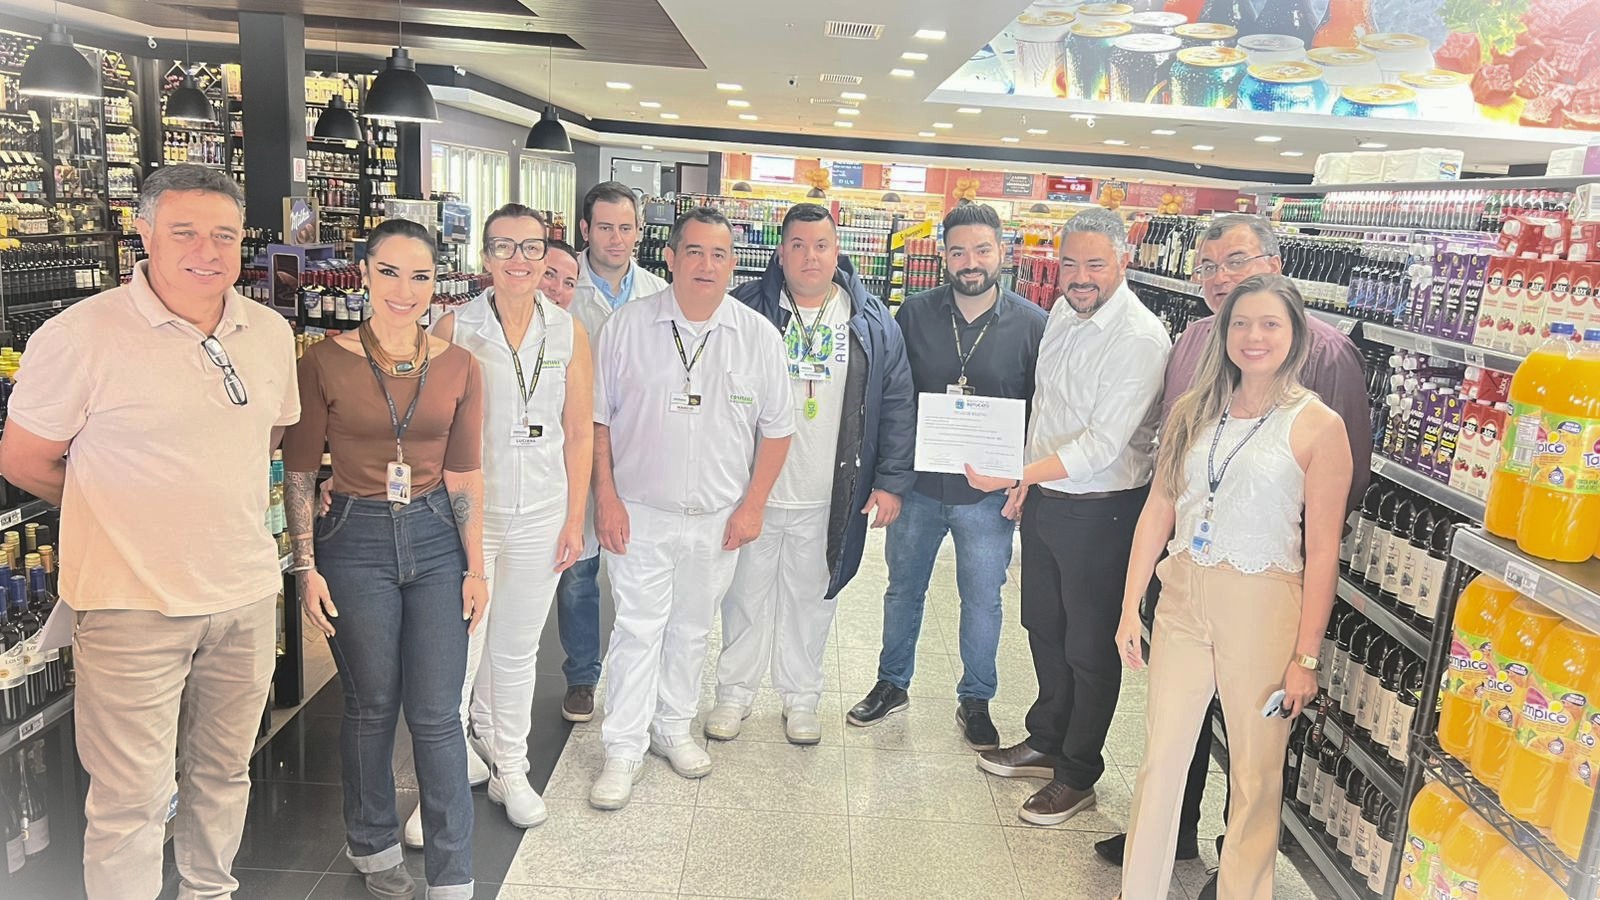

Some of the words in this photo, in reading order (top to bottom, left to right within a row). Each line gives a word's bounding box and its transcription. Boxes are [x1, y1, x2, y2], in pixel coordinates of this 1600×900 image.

[290, 207, 310, 231] Milka
[835, 323, 846, 363] ANOS
[1536, 443, 1565, 455] pico
[1450, 656, 1489, 671] mpico
[1488, 679, 1513, 693] pico
[1523, 703, 1568, 723] mpico
